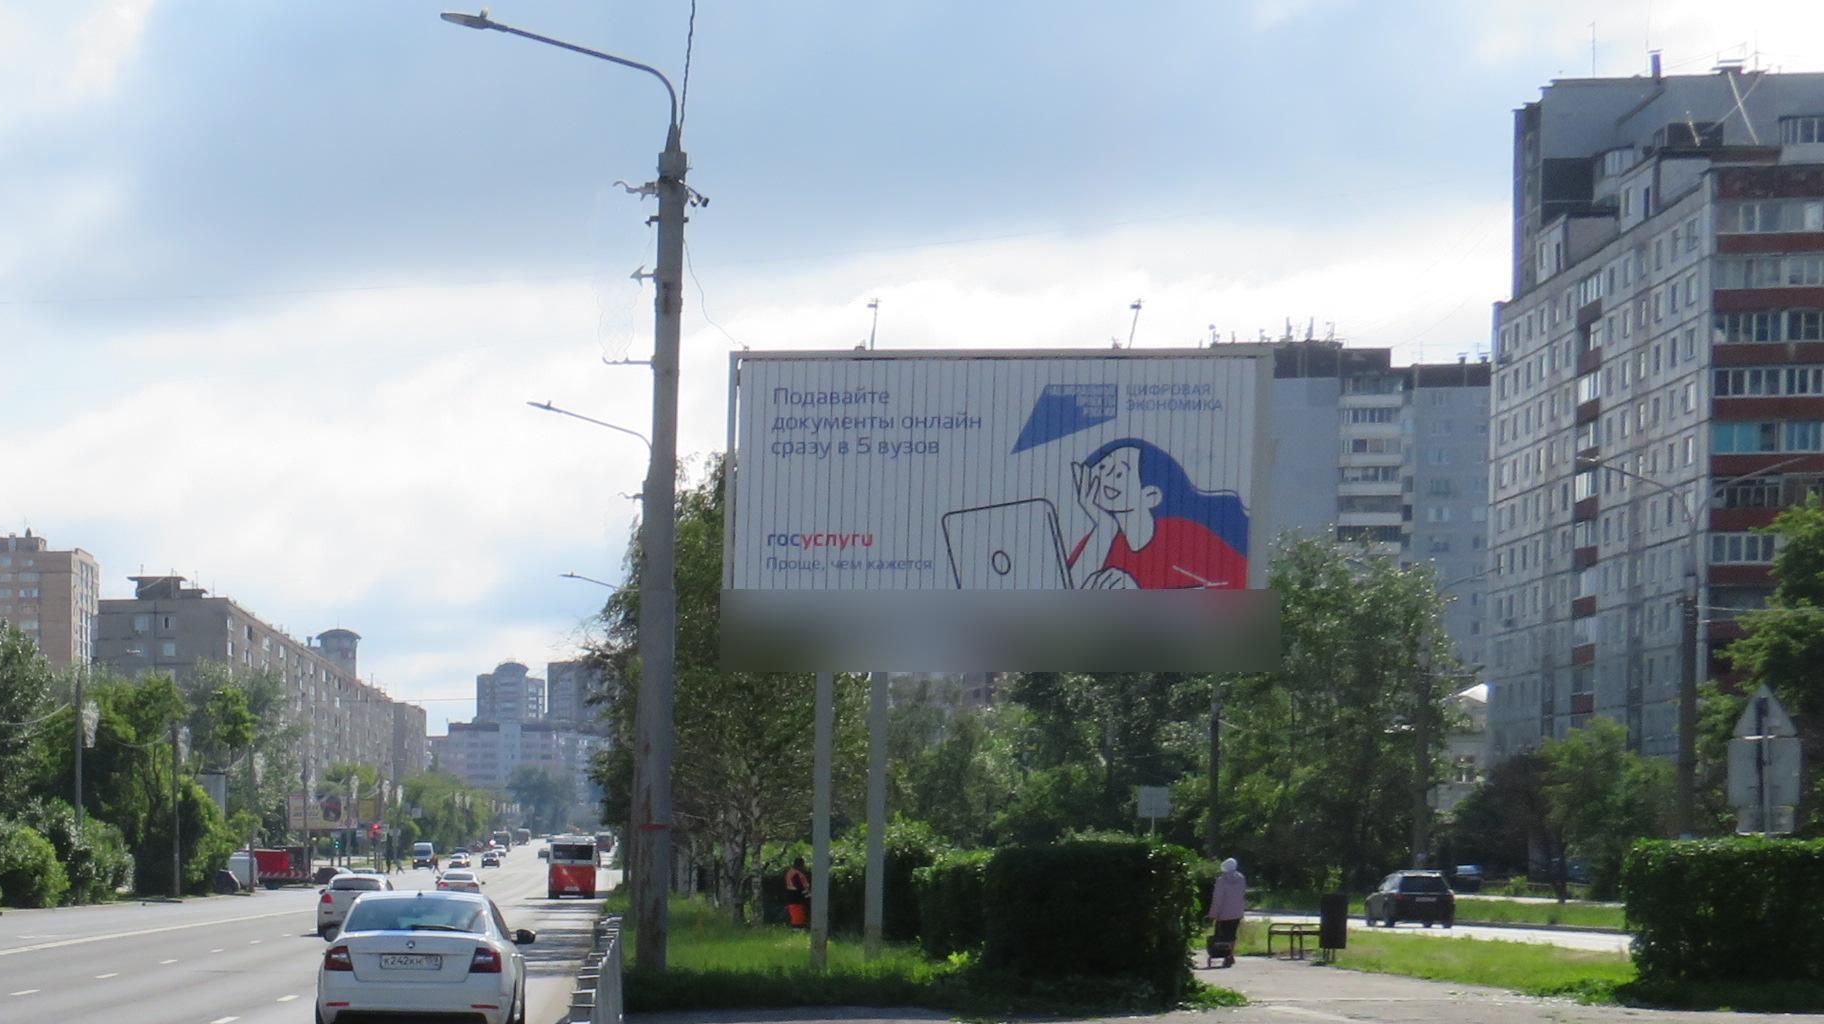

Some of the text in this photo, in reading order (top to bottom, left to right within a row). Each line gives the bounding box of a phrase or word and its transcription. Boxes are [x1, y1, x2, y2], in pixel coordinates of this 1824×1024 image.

[773, 386, 890, 407] Подавайте
[1126, 383, 1212, 397] ЦИФРОВАЯ
[1126, 399, 1223, 413] ЭКОНОМИКА
[771, 410, 982, 434] документы онлайн
[770, 436, 939, 459] сразу в 5 вузов
[766, 556, 933, 571] Проще, чем кажется
